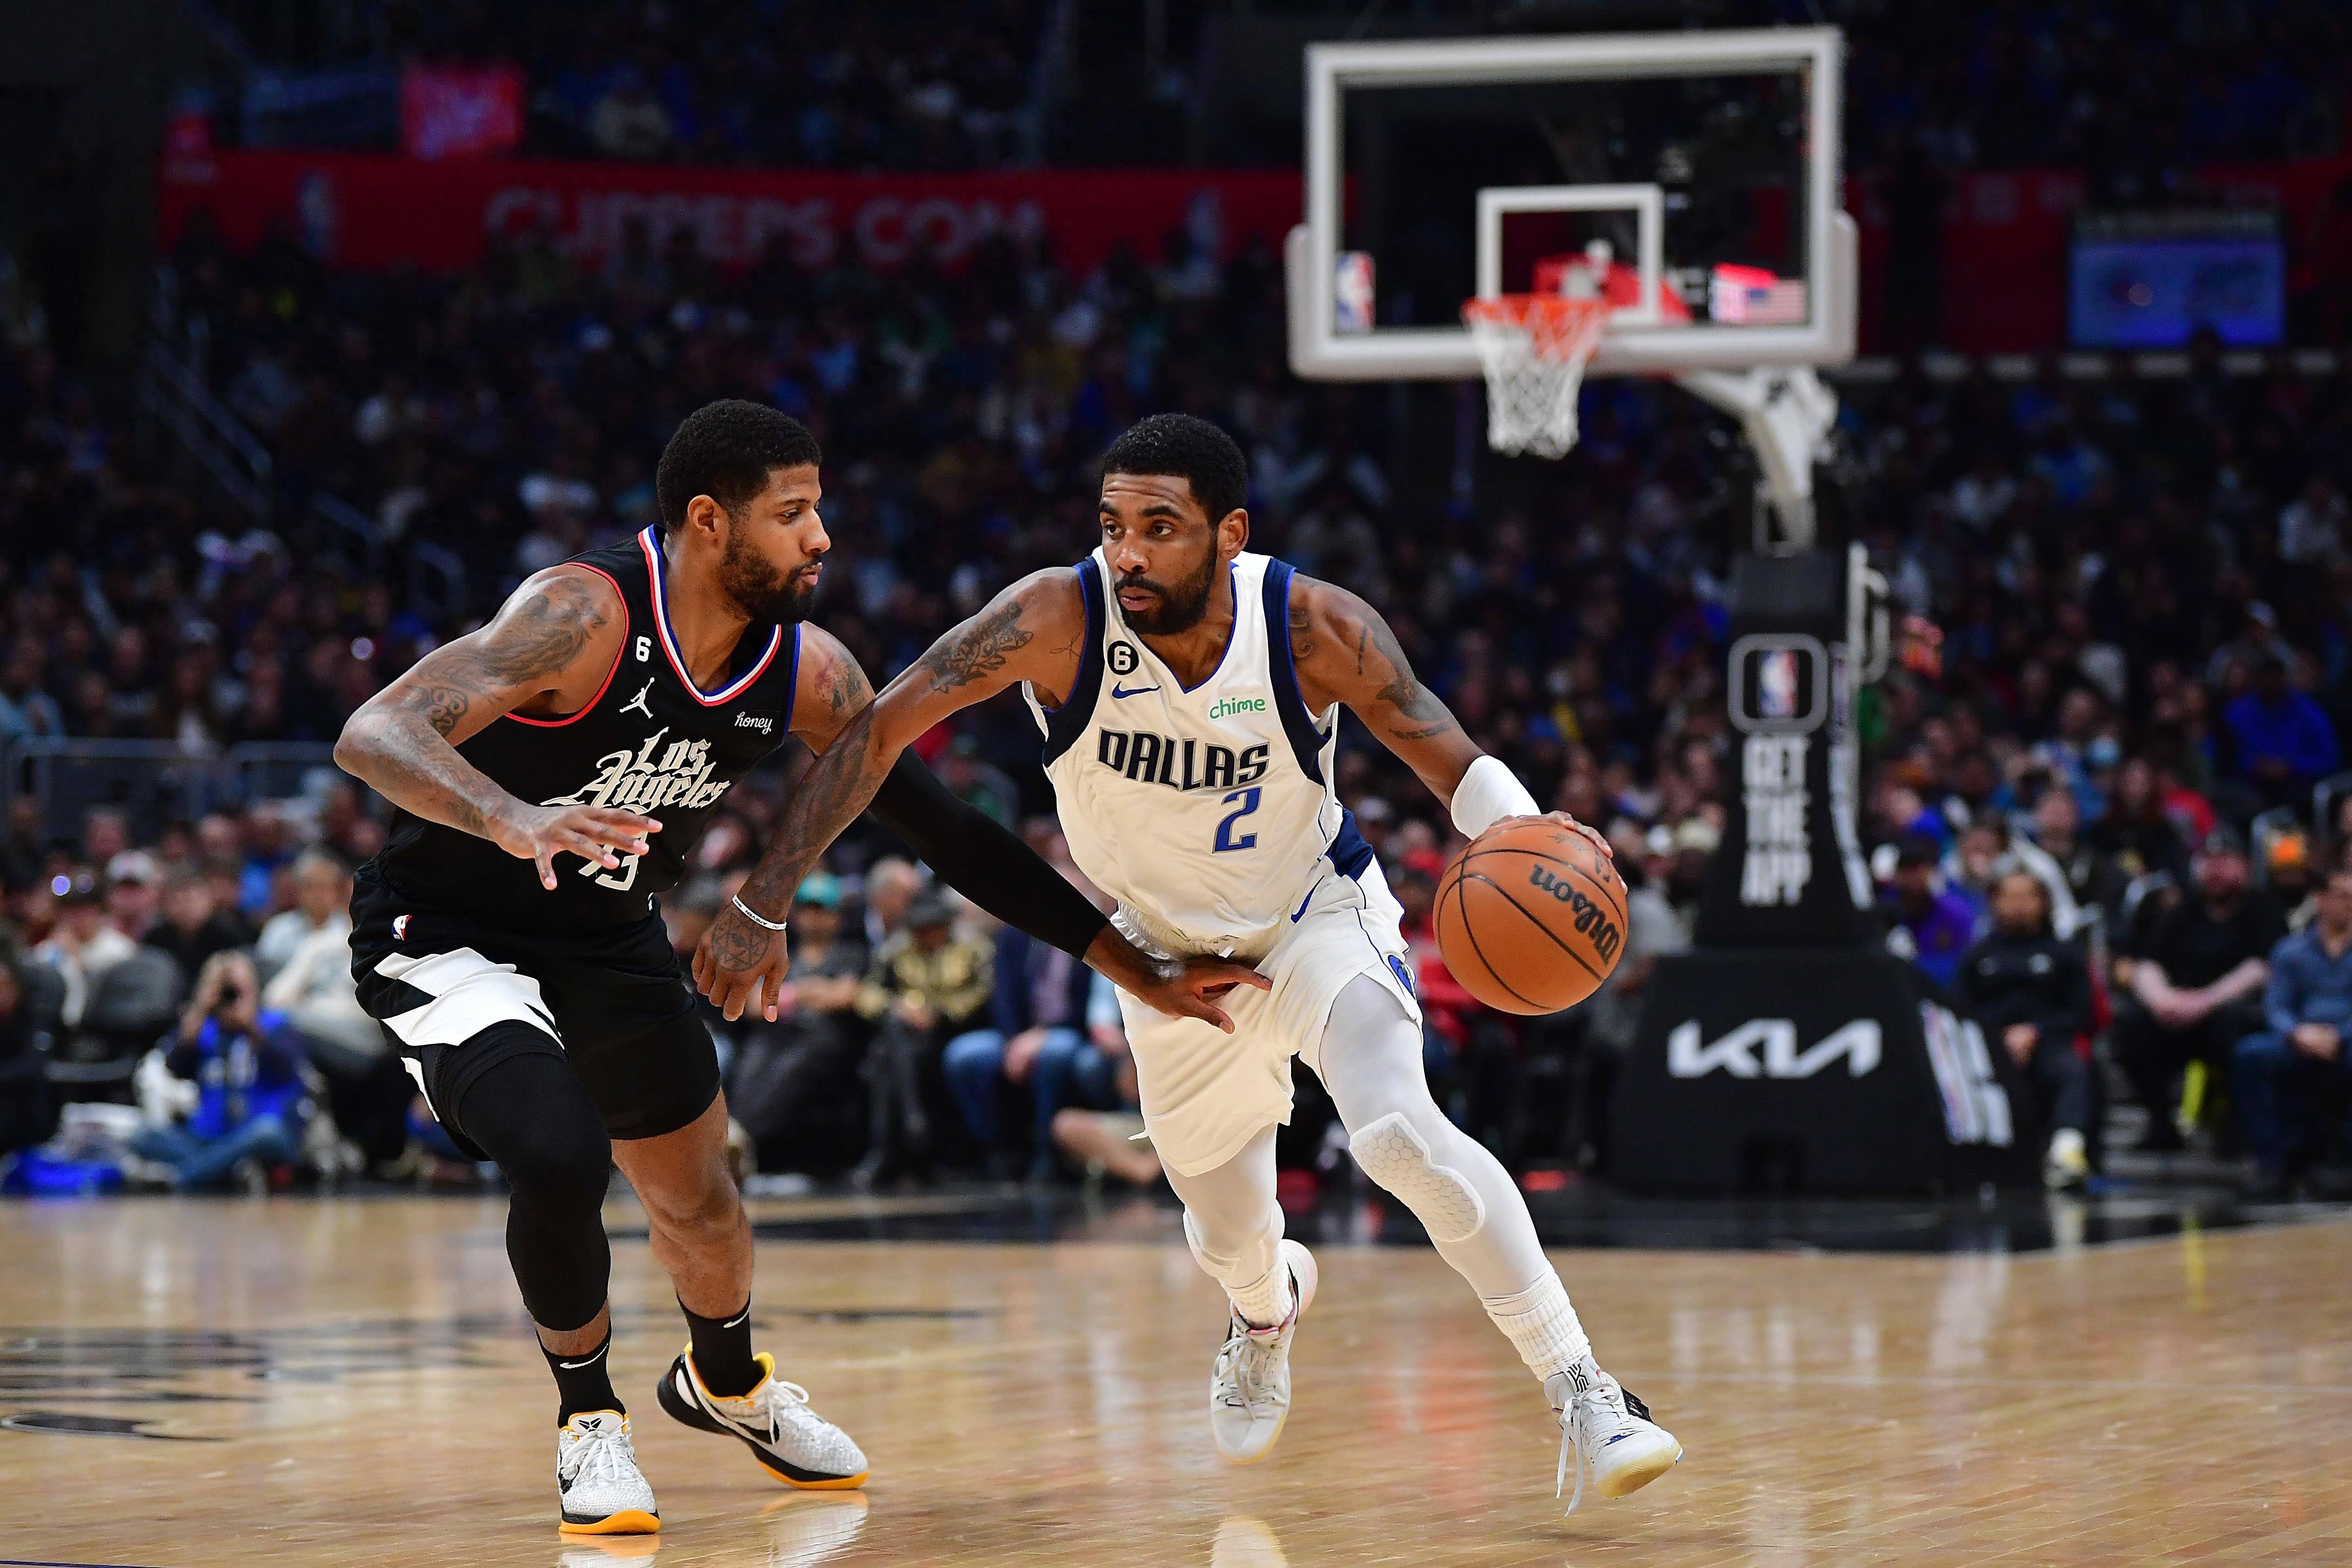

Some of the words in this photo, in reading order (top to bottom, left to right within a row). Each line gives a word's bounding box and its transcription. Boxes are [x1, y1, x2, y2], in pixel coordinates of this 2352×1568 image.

[636, 636, 652, 663] 6
[1113, 645, 1132, 671] 6
[734, 711, 773, 735] honey
[1209, 697, 1266, 720] chime
[625, 726, 712, 776] Los
[1098, 726, 1270, 792] DALLAS
[540, 750, 732, 815] Angeles
[1211, 785, 1263, 854] 2
[1529, 863, 1619, 966] Wilson
[1666, 1017, 1883, 1079] KIA
